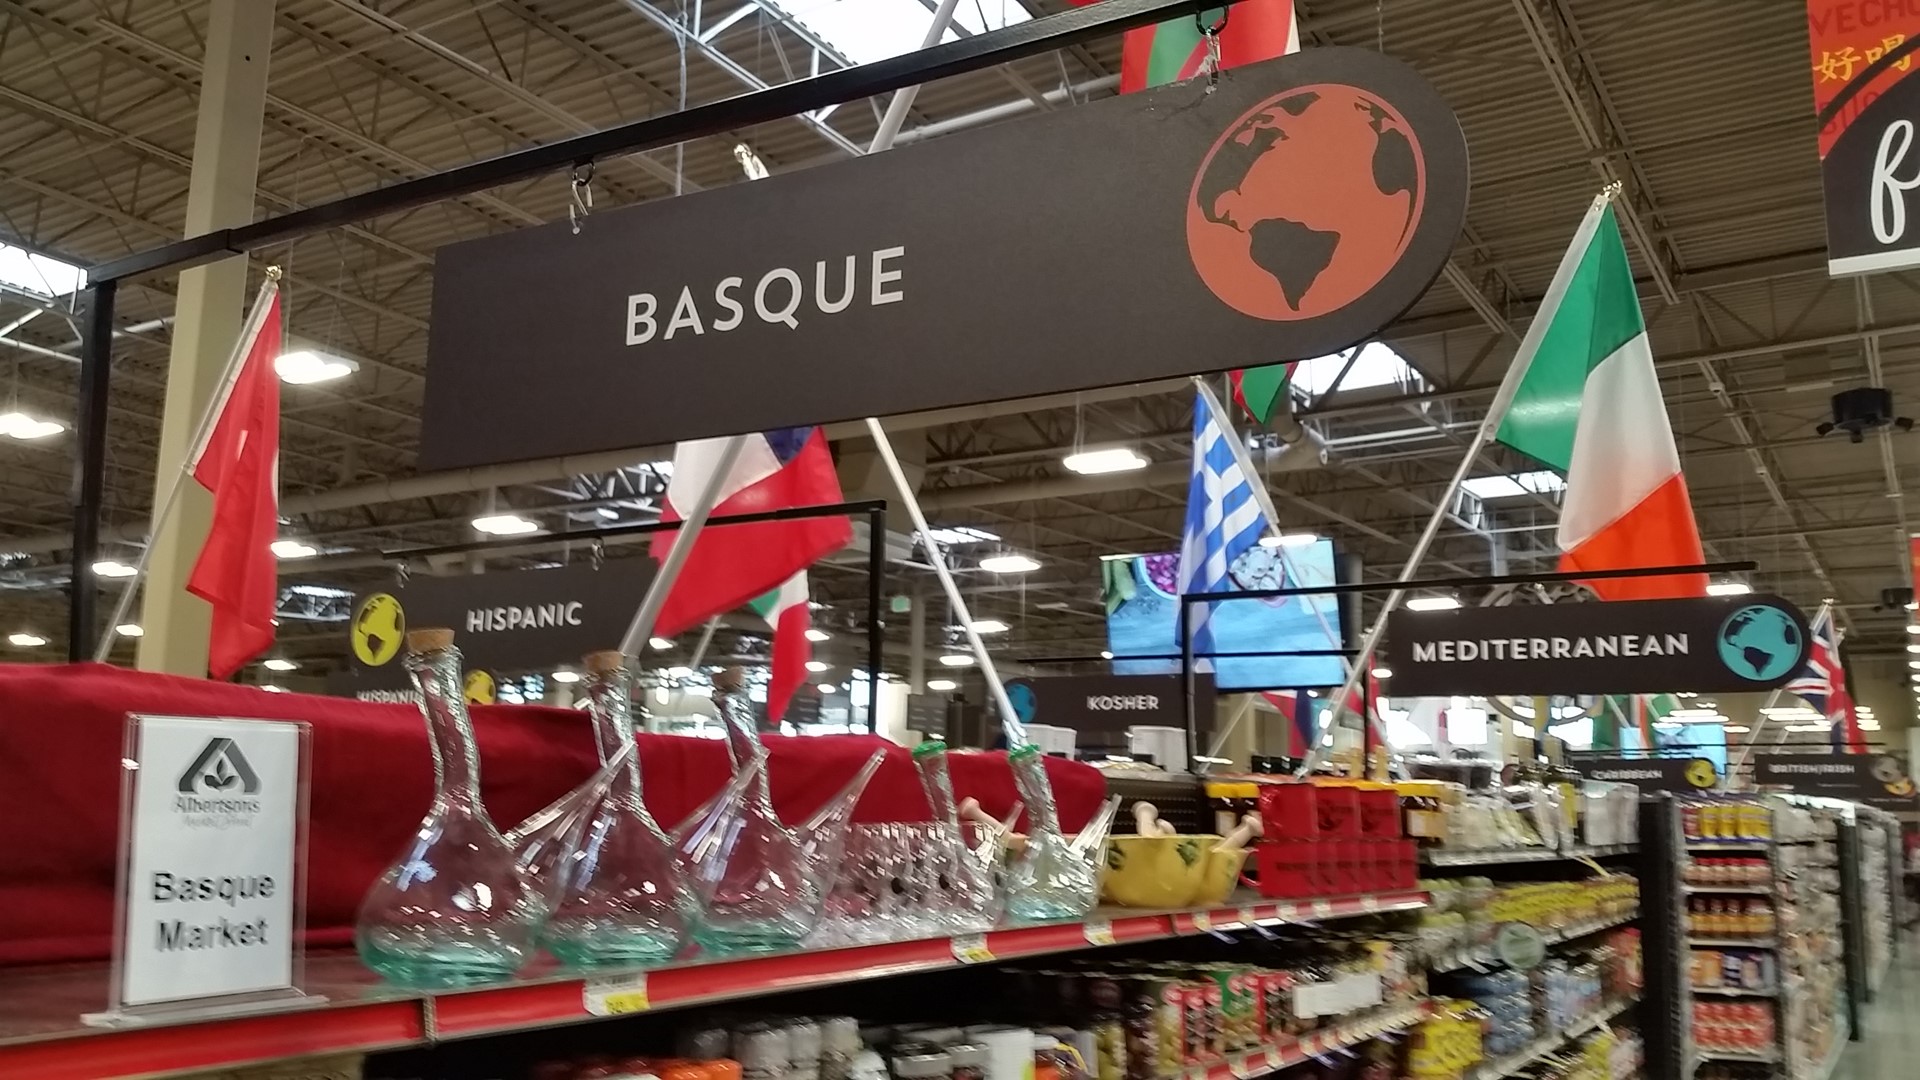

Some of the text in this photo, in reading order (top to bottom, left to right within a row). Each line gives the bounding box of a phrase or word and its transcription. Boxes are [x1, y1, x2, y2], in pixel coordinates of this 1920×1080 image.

[626, 246, 905, 346] BASQUE
[466, 601, 583, 633] HISPANIC
[1412, 633, 1690, 663] MEDITERRANEAN
[357, 689, 425, 705] HISPANI
[1087, 695, 1159, 710] KOSHER
[173, 796, 261, 814] Albertsons
[154, 870, 277, 908] Basque
[157, 916, 269, 952] Market
